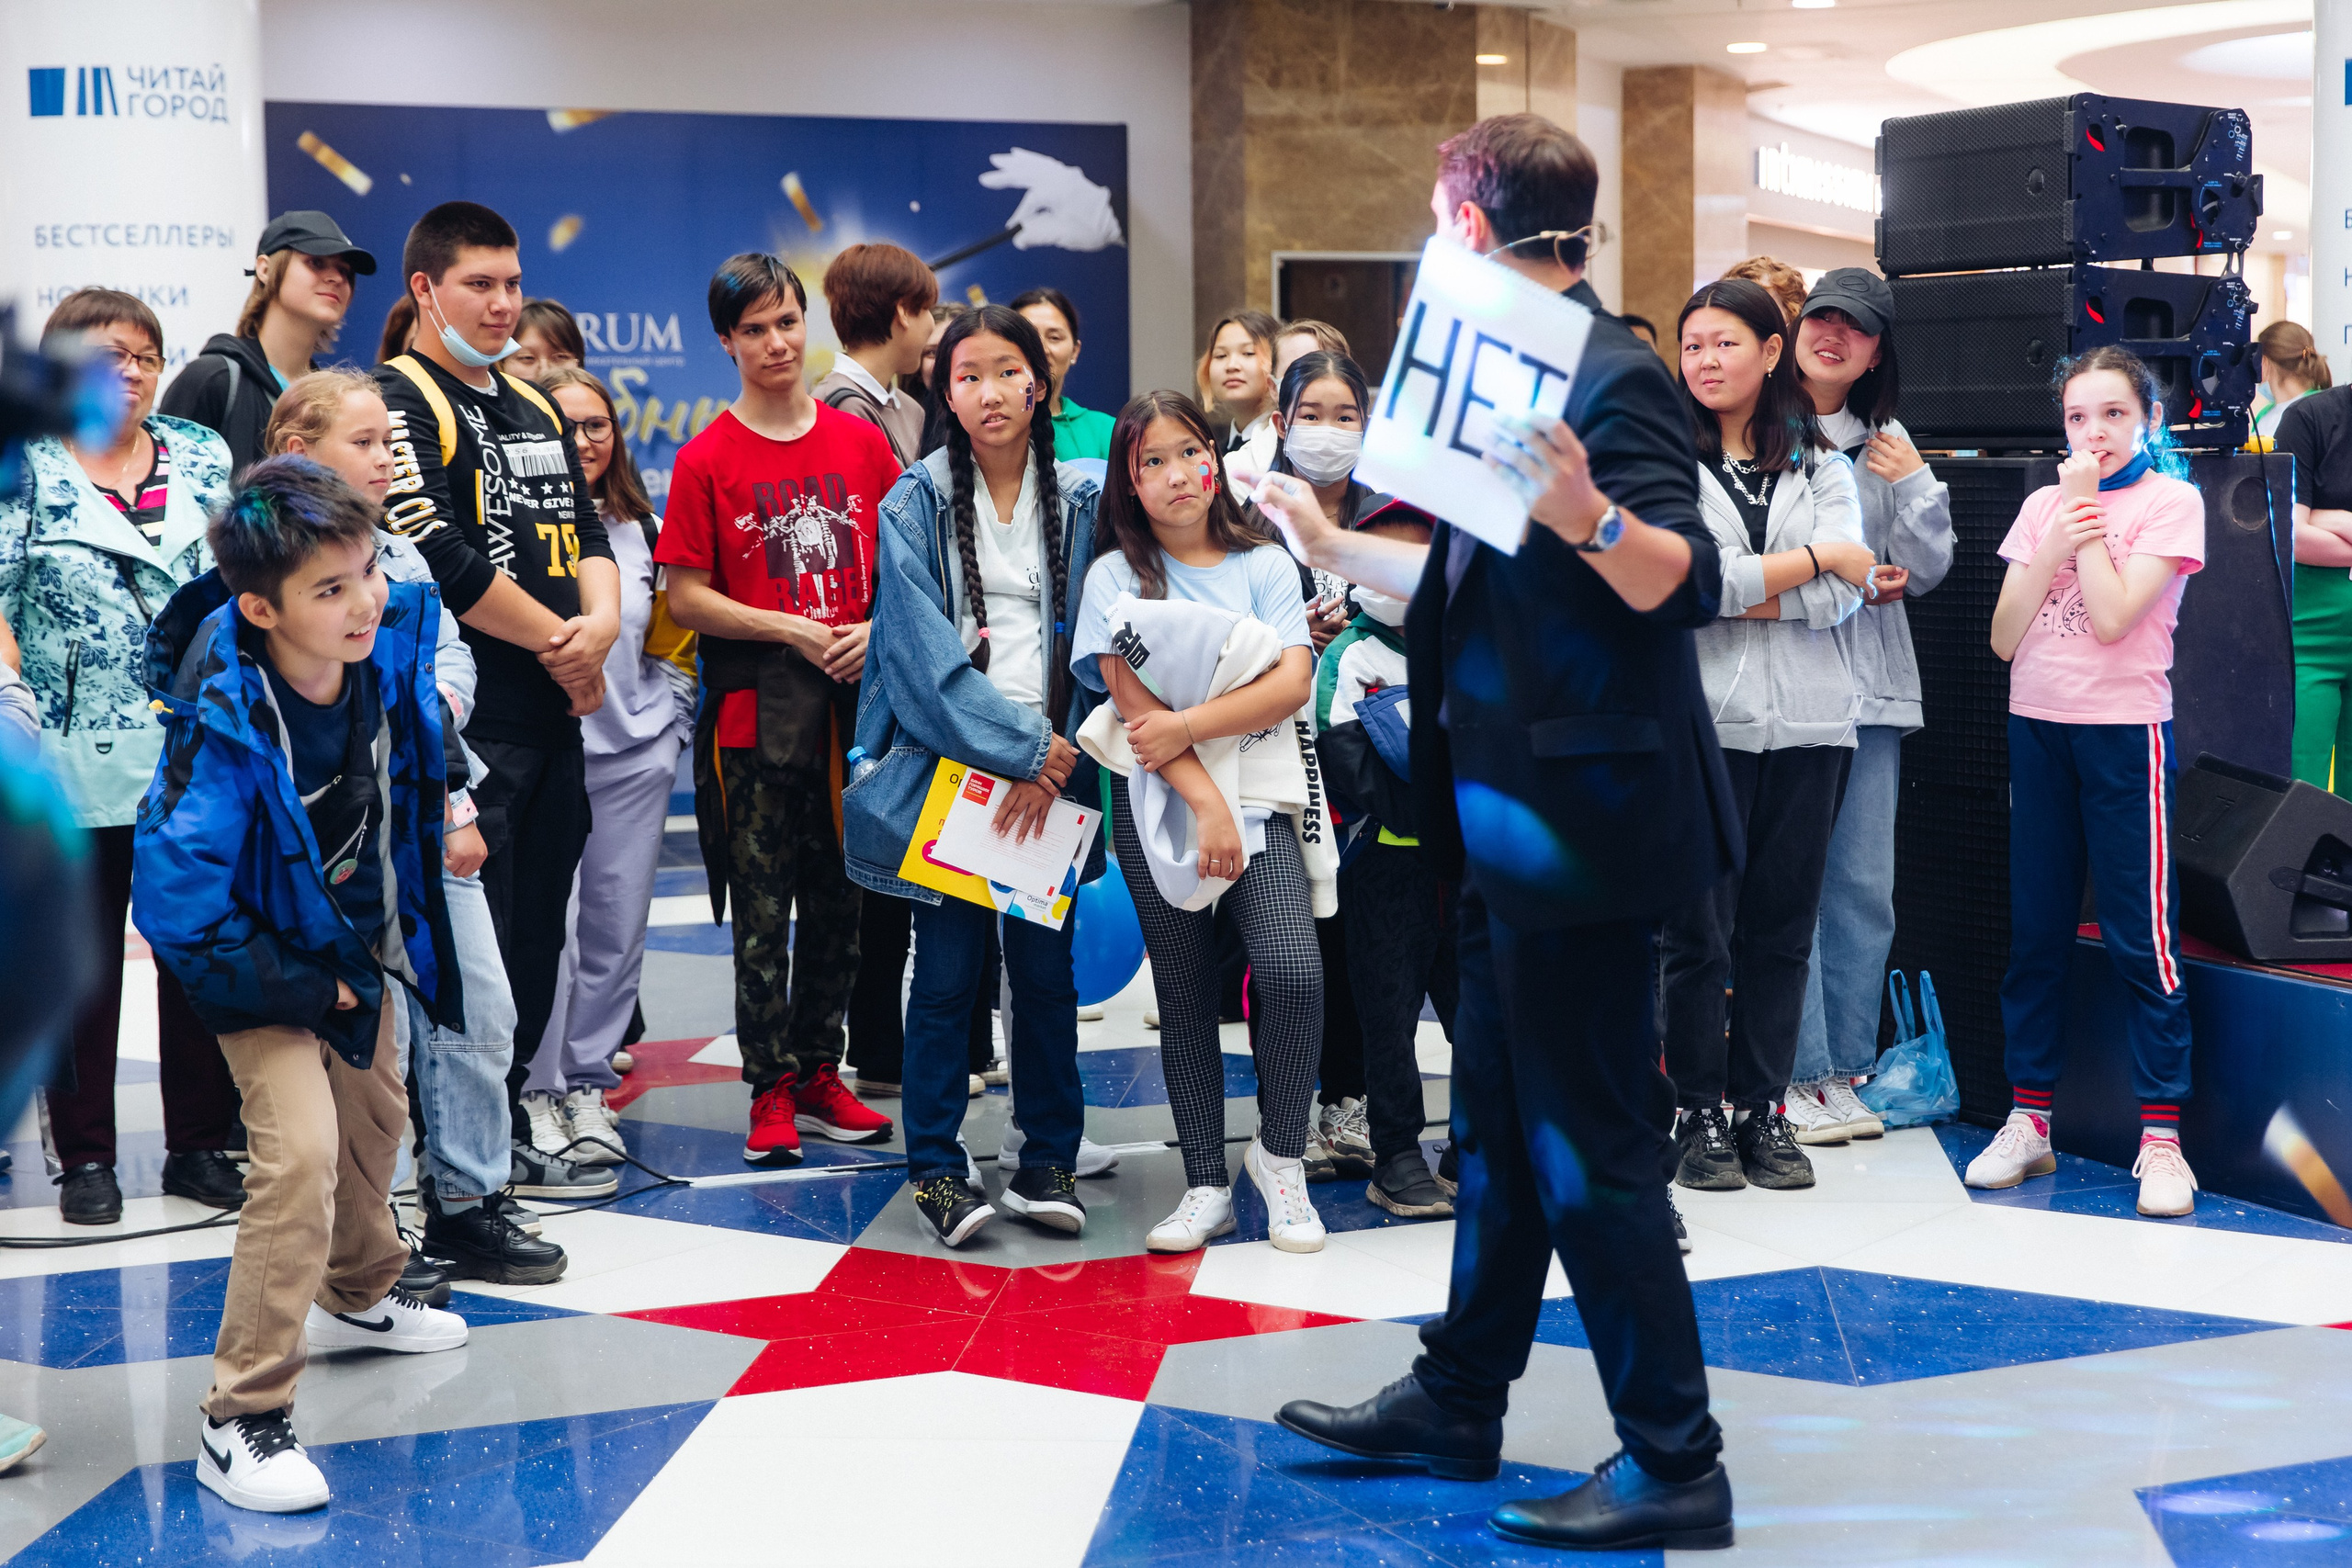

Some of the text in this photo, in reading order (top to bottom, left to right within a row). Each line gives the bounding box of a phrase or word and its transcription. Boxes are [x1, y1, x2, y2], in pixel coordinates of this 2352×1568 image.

[127, 63, 226, 92] ЧИТАЙ
[128, 94, 229, 123] ГОРОД
[34, 223, 234, 248] БЕСТСЕЛЛЕРЫ
[38, 285, 191, 307] НОНКИ
[575, 312, 684, 353] RUM
[1385, 300, 1568, 461] НЕТ
[458, 404, 518, 581] AWESOME
[509, 491, 540, 509] NEVER
[752, 473, 849, 520] ROAD
[1295, 720, 1321, 844] HAPPINESS
